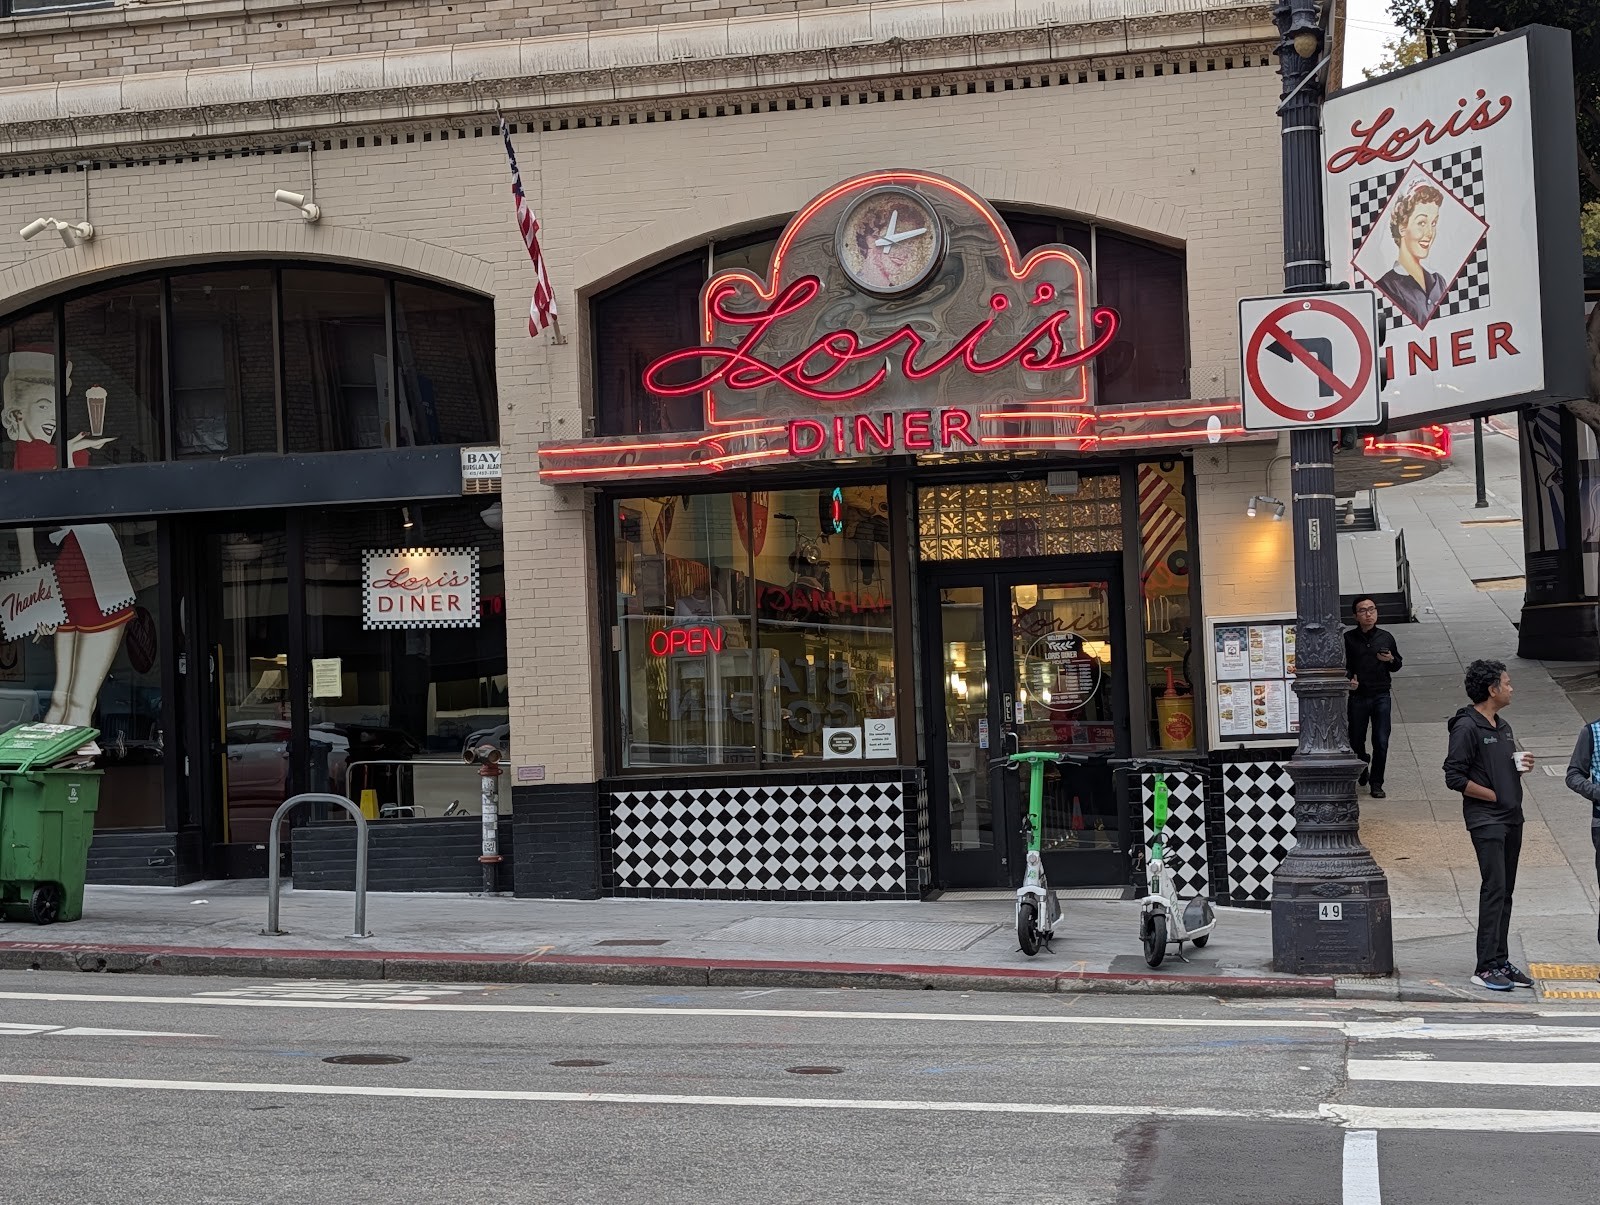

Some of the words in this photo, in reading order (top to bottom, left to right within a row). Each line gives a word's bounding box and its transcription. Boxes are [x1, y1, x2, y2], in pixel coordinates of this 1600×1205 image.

[1327, 89, 1512, 174] Lori's
[642, 275, 1118, 400] Lori's
[1386, 320, 1520, 380] INER
[788, 408, 978, 456] DINER
[467, 453, 500, 463] BAY
[372, 567, 469, 591] Lori's
[1, 578, 54, 621] Thanks
[378, 594, 461, 613] DINER
[650, 626, 723, 657] OPEN
[1321, 905, 1340, 918] 49
